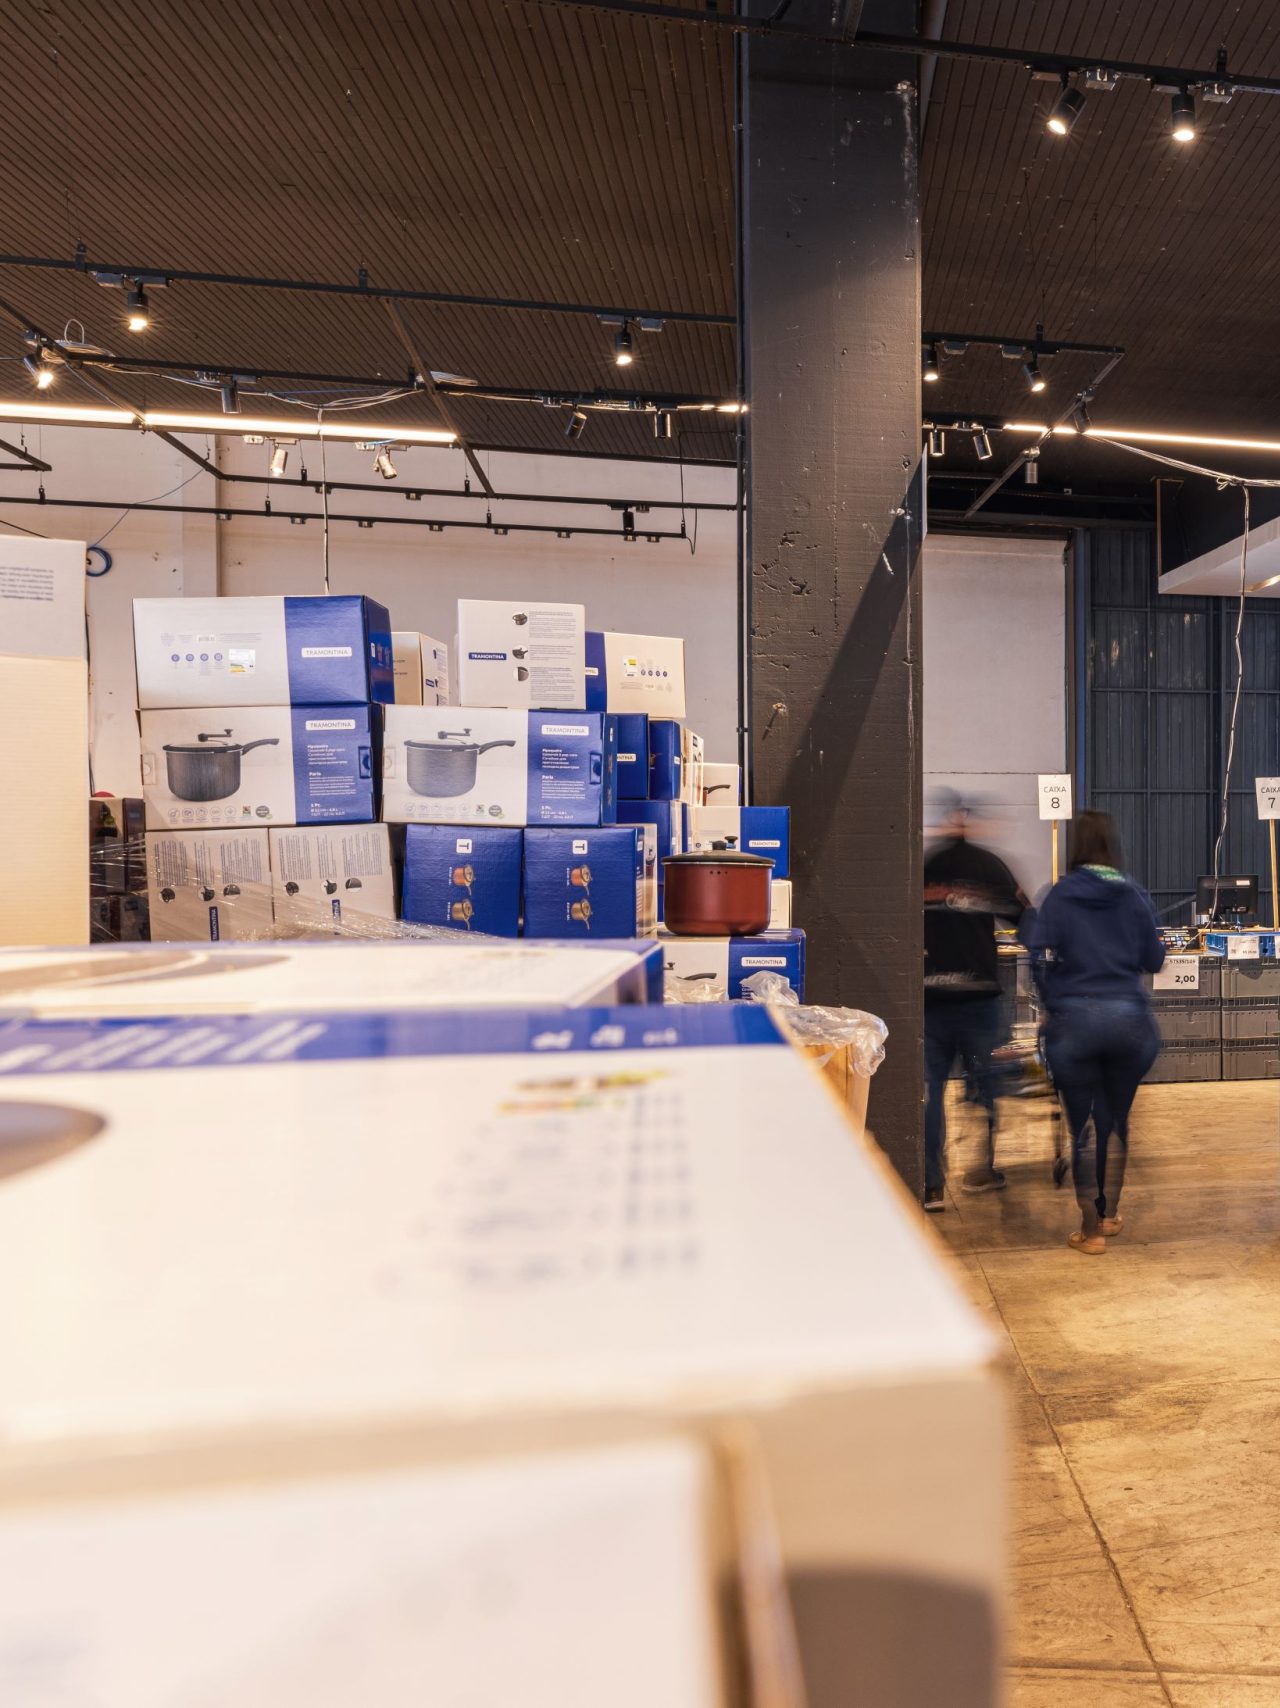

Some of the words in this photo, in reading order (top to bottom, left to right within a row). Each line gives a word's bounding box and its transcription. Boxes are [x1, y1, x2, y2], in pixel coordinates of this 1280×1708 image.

[1051, 797, 1060, 809] 8
[1268, 798, 1276, 809] 7
[1175, 975, 1195, 985] 2,00
